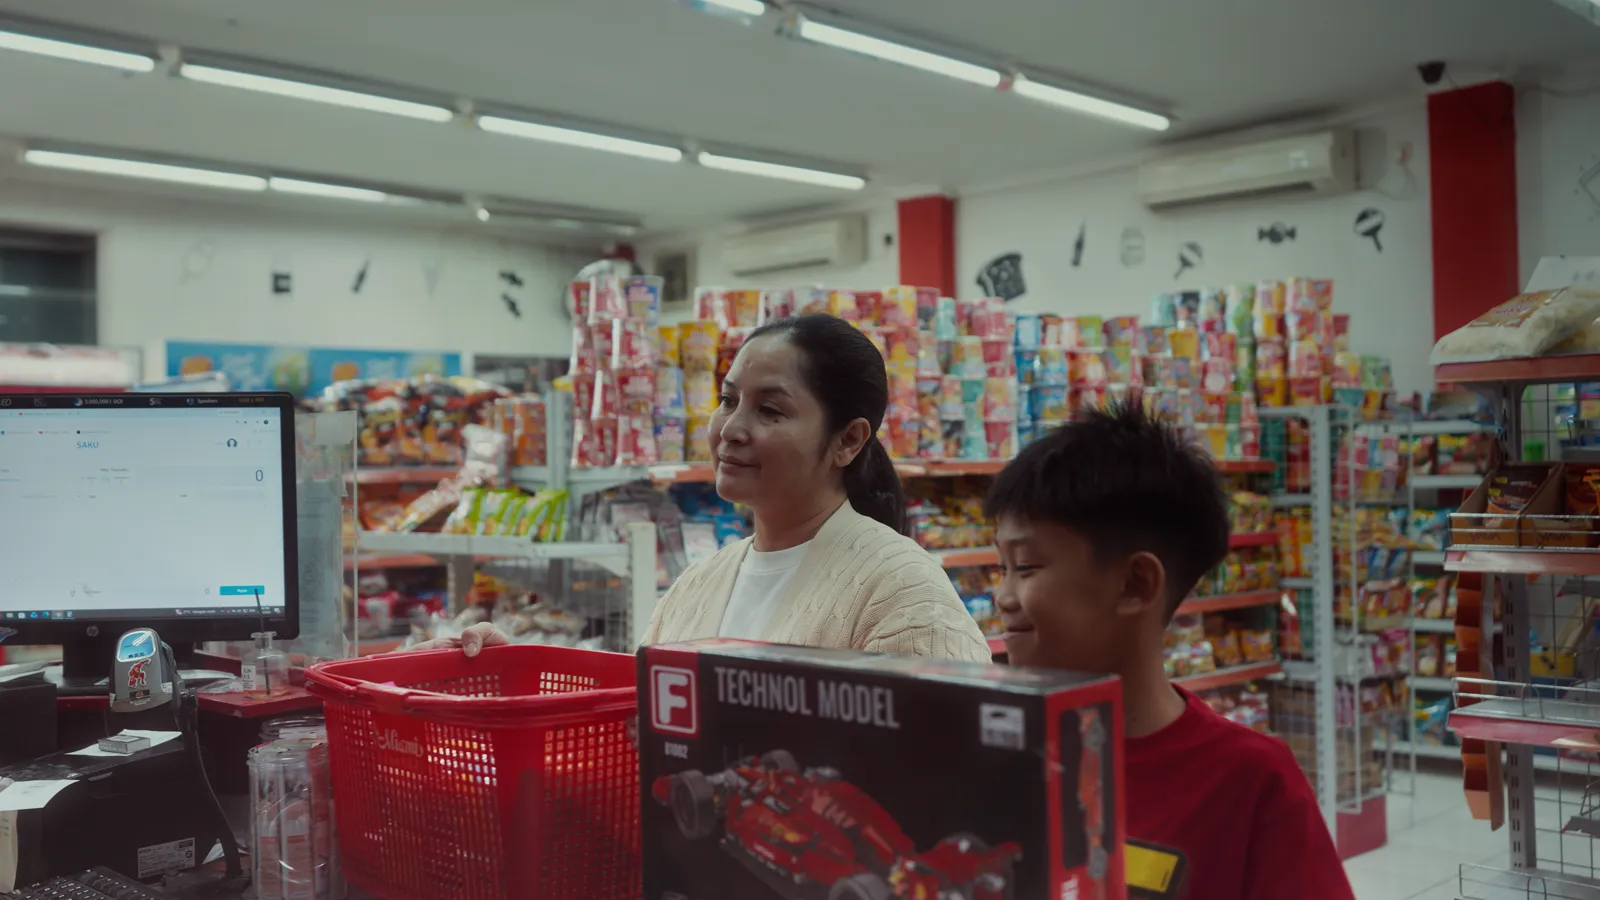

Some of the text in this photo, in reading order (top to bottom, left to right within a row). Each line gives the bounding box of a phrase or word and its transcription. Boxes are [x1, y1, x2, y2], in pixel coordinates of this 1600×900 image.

[76, 441, 99, 449] SAKU
[255, 469, 263, 481] 0
[658, 671, 689, 724] F
[714, 666, 901, 729] TECHNOL MODEL
